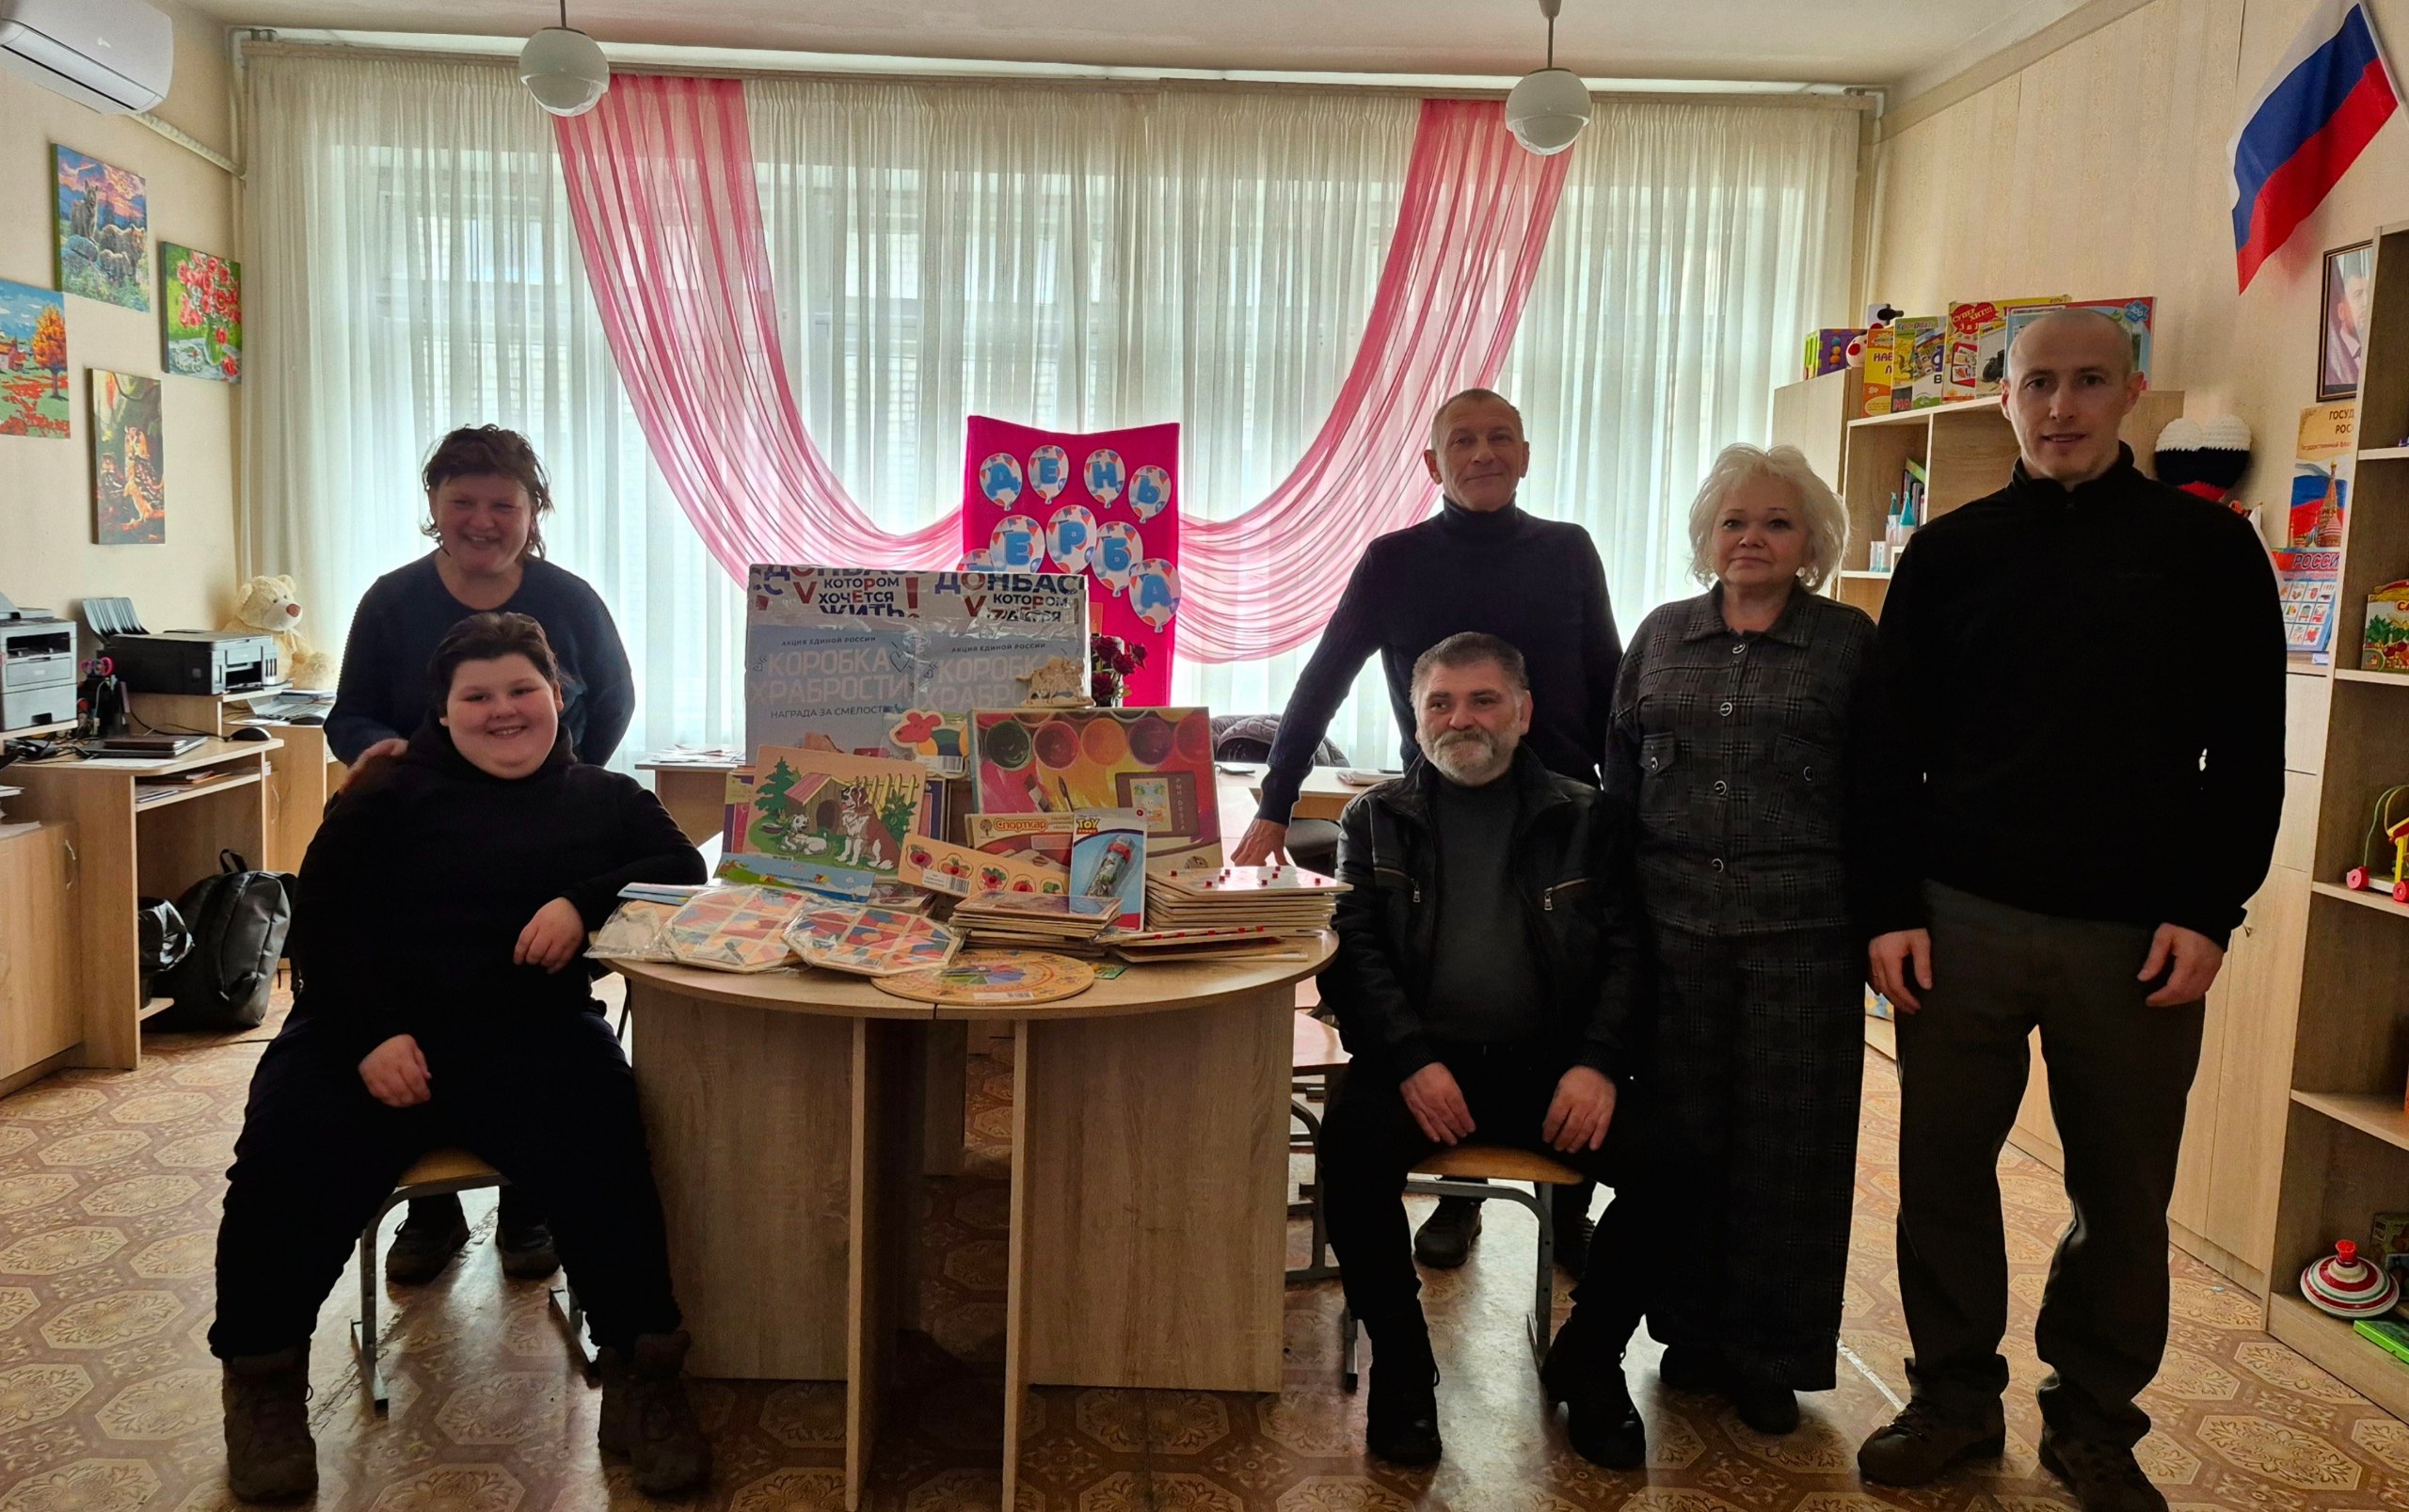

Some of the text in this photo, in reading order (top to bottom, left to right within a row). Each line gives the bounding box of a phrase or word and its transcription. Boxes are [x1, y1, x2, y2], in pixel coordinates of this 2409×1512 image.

[934, 571, 1086, 595] ДОНБАС
[819, 590, 894, 604] ХОЧЕТСЯ
[809, 637, 842, 645] ЕДИНОЙ
[844, 635, 876, 644] РОССИИ
[767, 647, 891, 676] КОРОБКА
[938, 655, 1041, 684] КОРОБК
[770, 709, 818, 719] НАГРАДА
[820, 708, 833, 717] ЗА
[995, 819, 1047, 833] Спорткар
[1077, 819, 1100, 829] TOY
